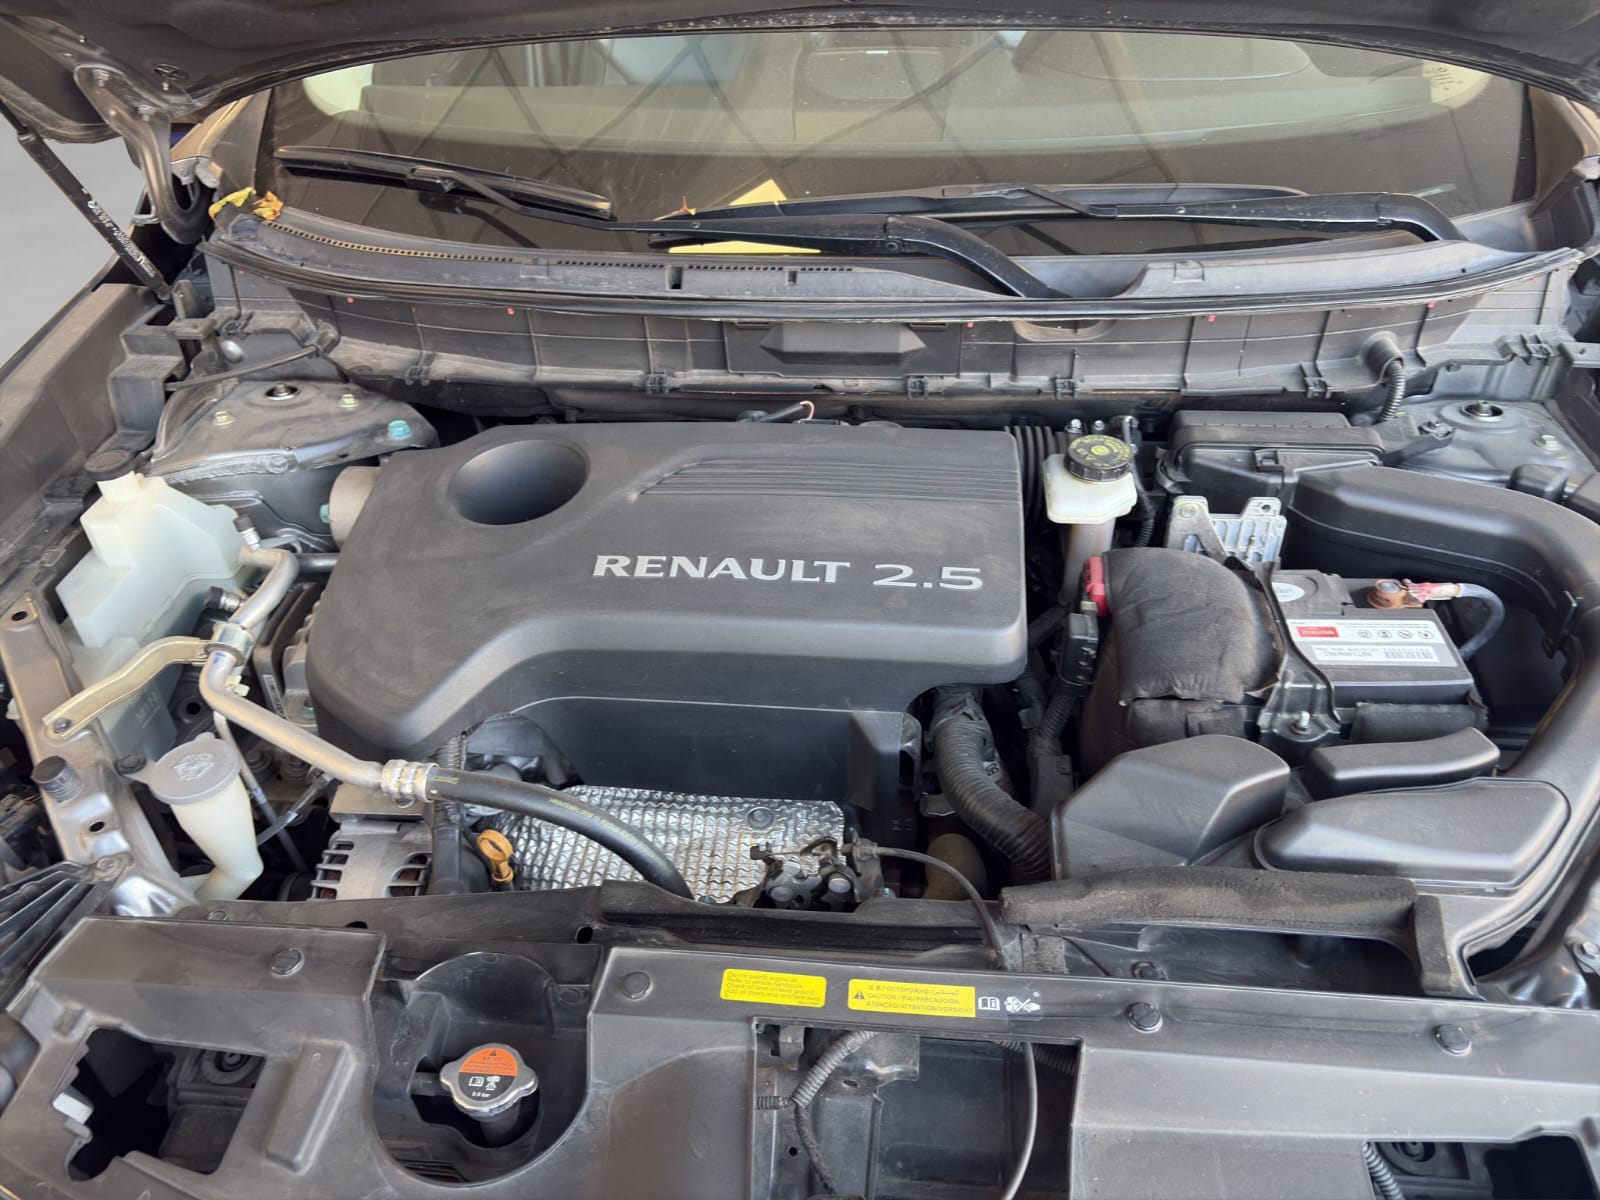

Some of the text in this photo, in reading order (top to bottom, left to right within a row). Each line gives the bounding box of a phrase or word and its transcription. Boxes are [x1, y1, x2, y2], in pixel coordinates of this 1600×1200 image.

[592, 554, 984, 590] RENAULT 2.5
[136, 691, 158, 723] MIN
